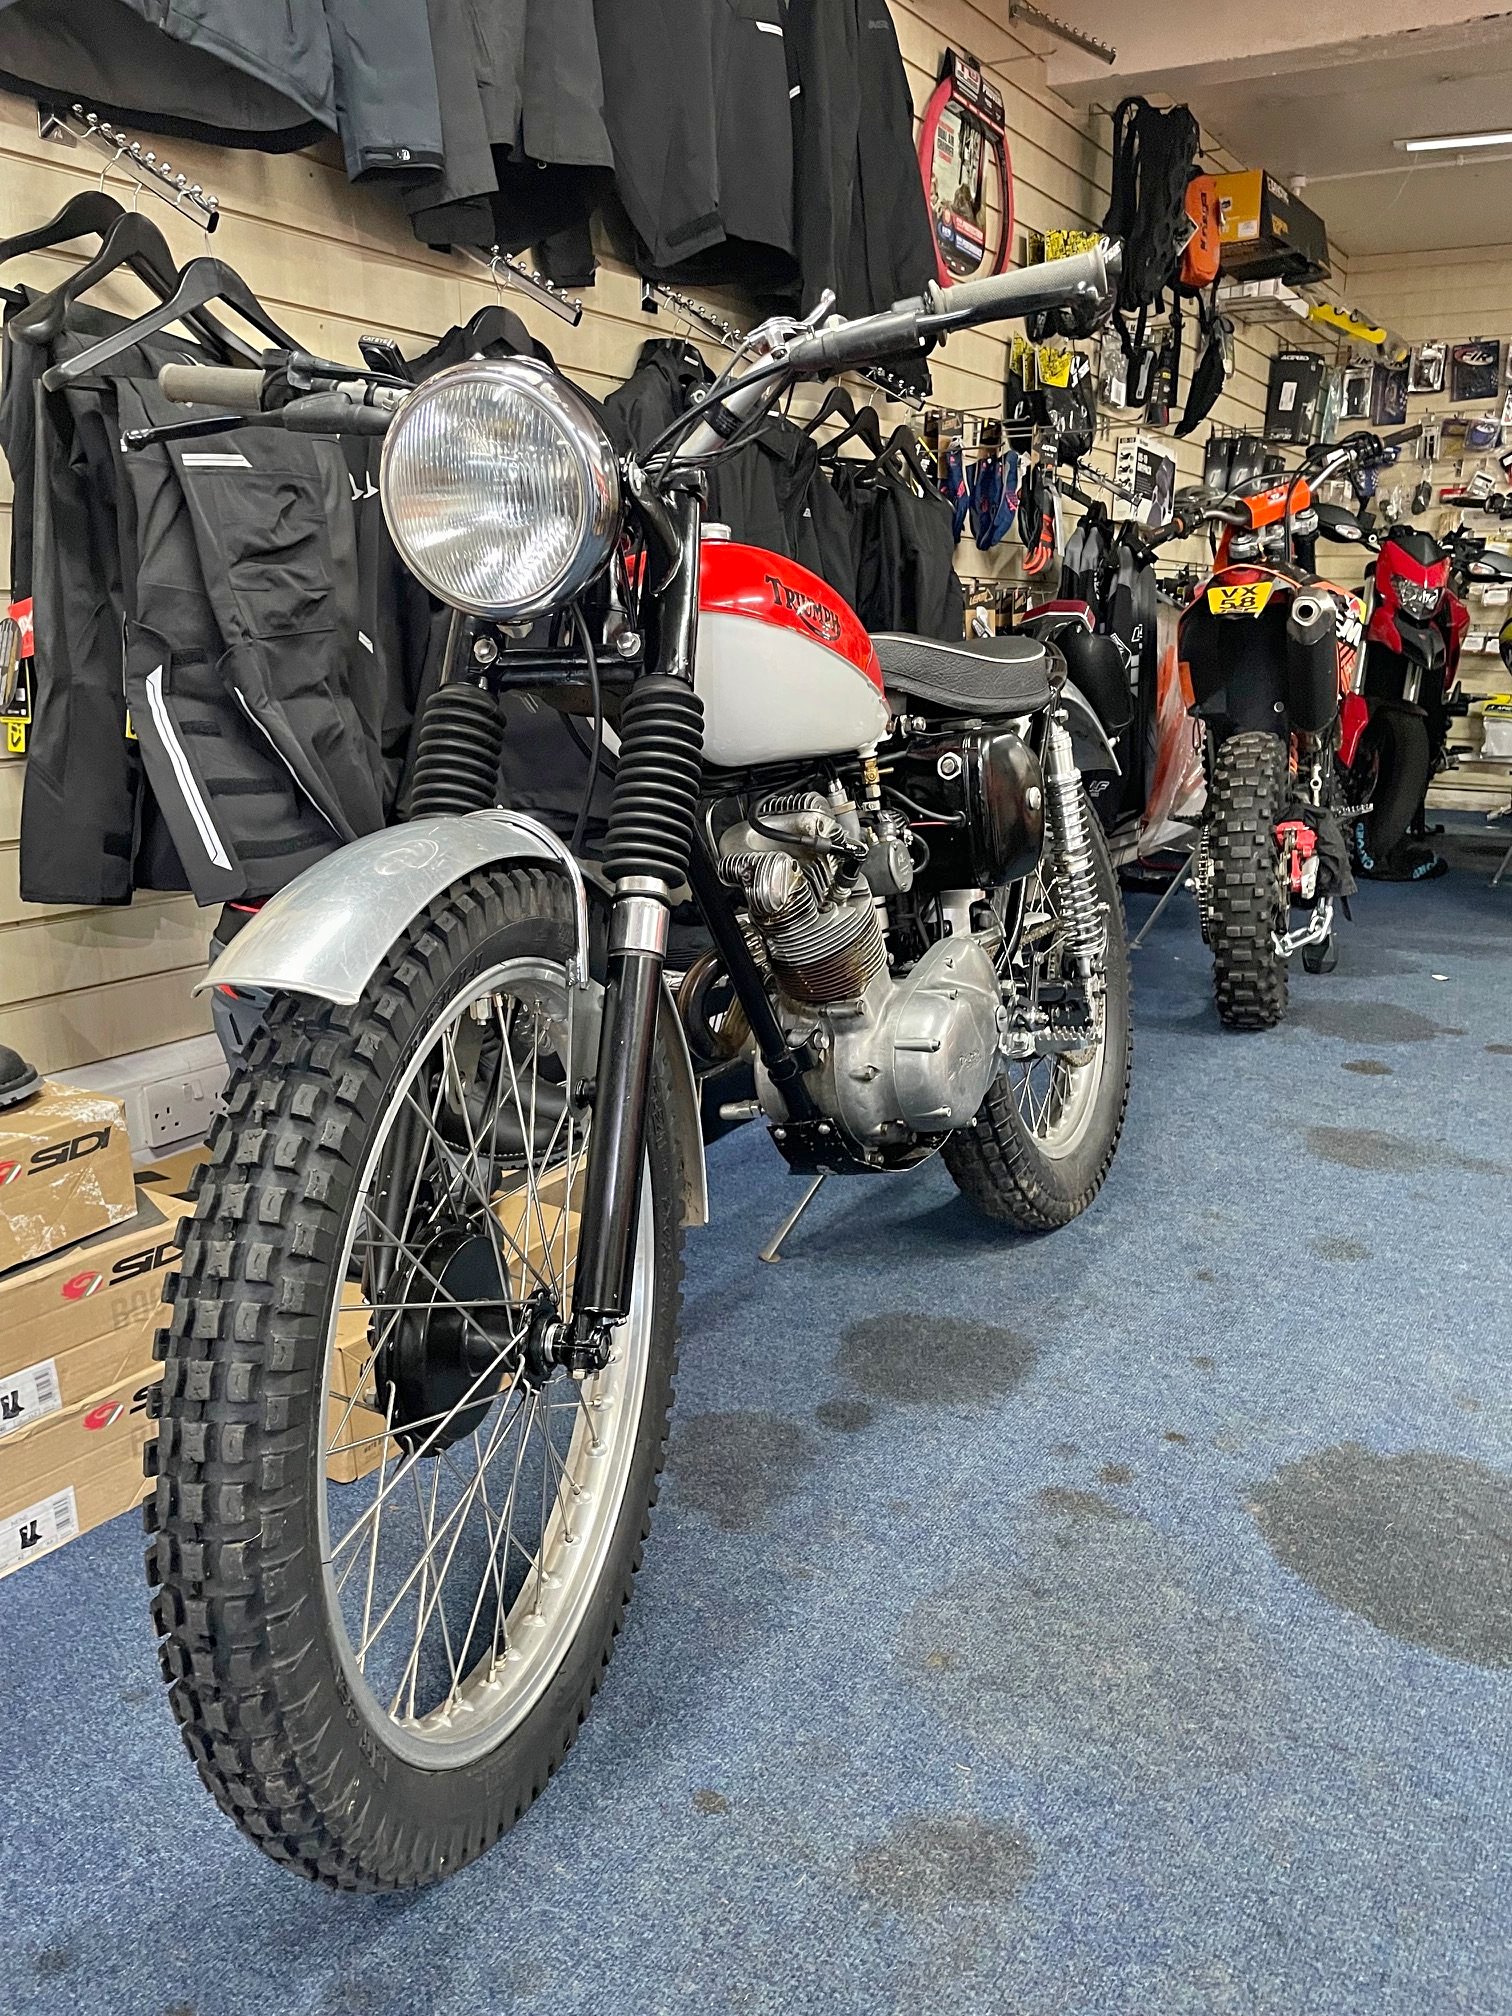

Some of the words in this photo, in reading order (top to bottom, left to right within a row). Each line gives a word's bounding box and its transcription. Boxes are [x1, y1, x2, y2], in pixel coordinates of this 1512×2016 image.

[763, 574, 841, 641] TRIUMPH
[1221, 585, 1258, 597] VX
[27, 1125, 113, 1176] SIDI
[108, 1240, 185, 1287] SID
